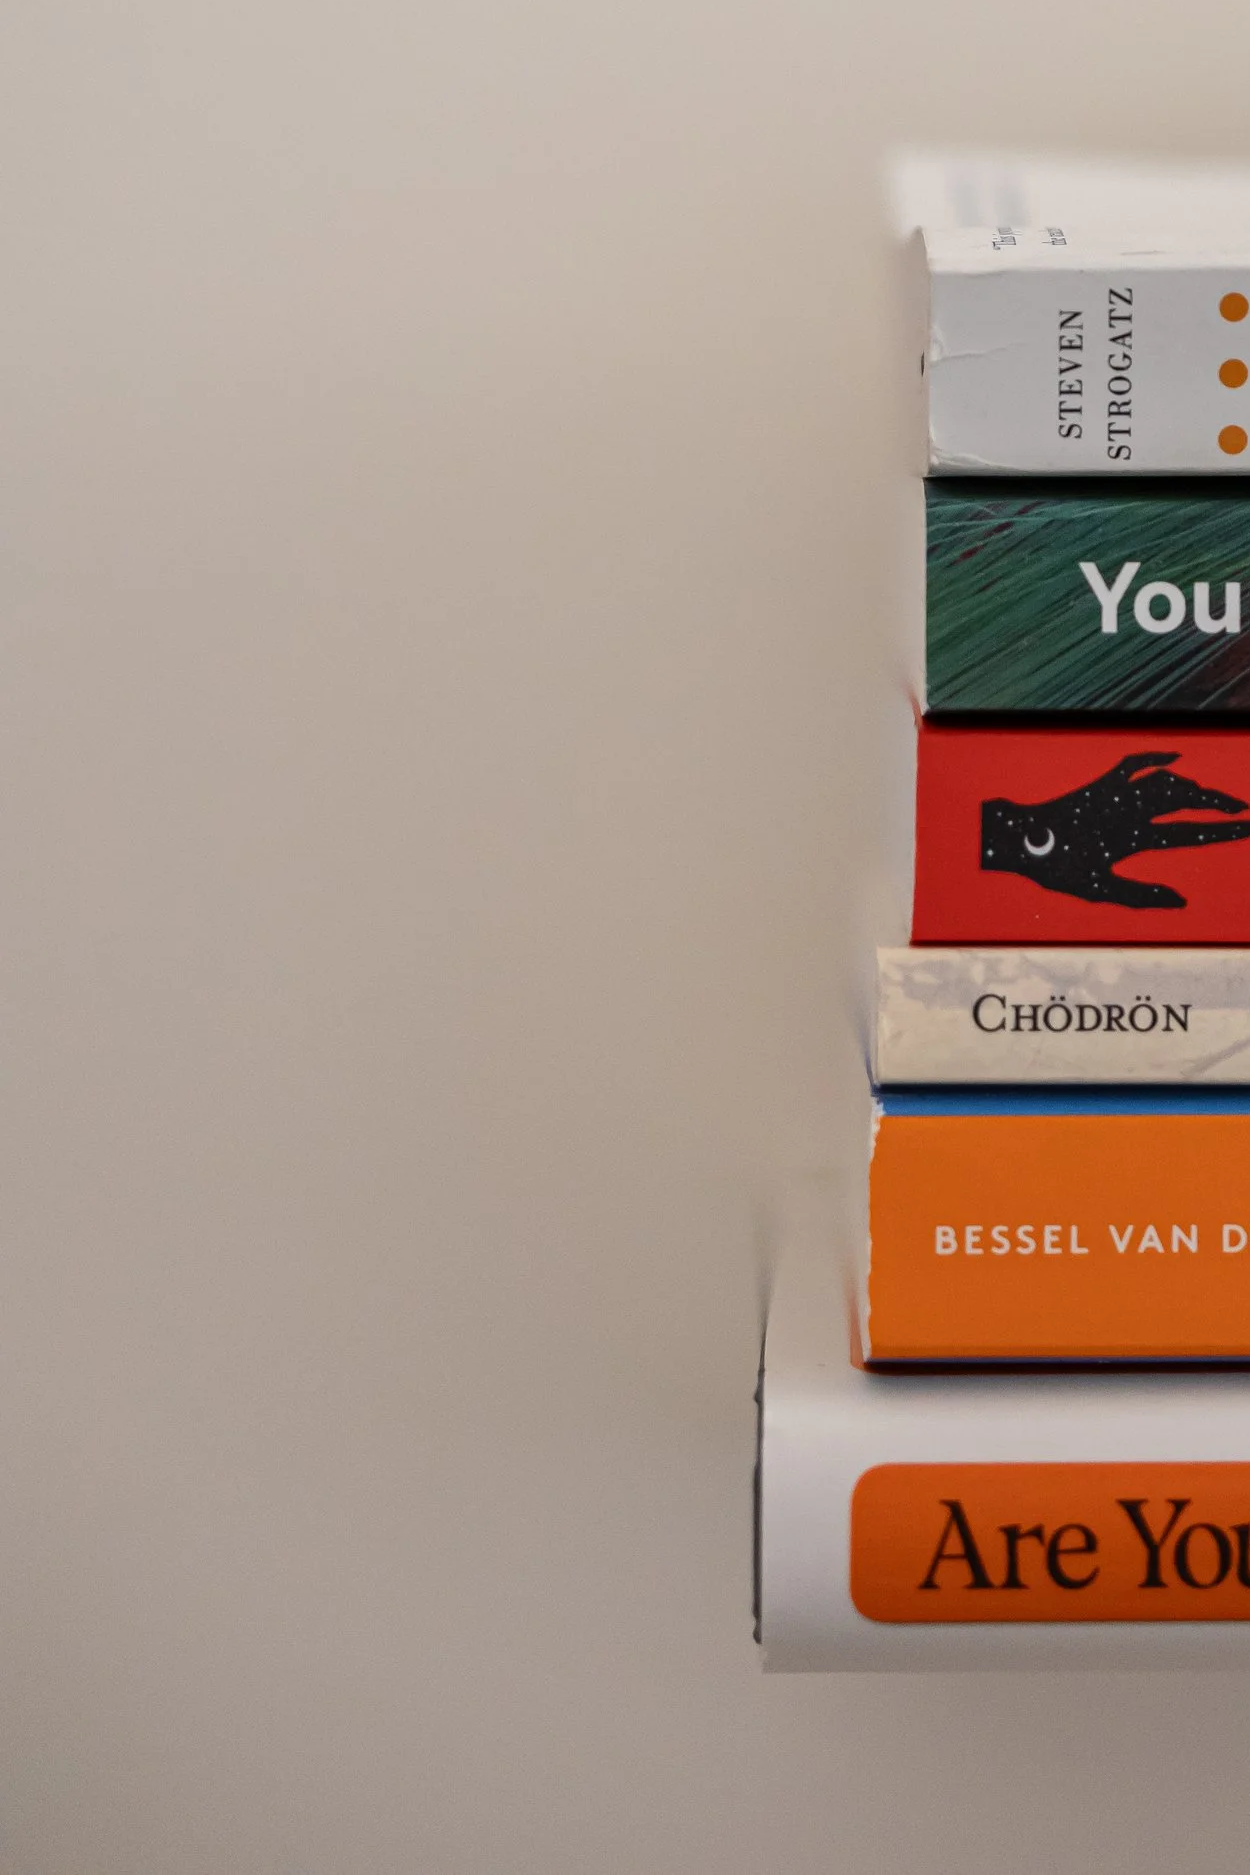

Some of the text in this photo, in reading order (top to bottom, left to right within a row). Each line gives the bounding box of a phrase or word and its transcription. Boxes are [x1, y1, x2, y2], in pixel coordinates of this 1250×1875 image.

[1058, 310, 1084, 439] STEVEN
[1107, 287, 1133, 461] STROGATZ
[935, 1224, 1089, 1256] BESSEL
[1108, 1224, 1199, 1254] VAN
[917, 1500, 1099, 1591] Are
